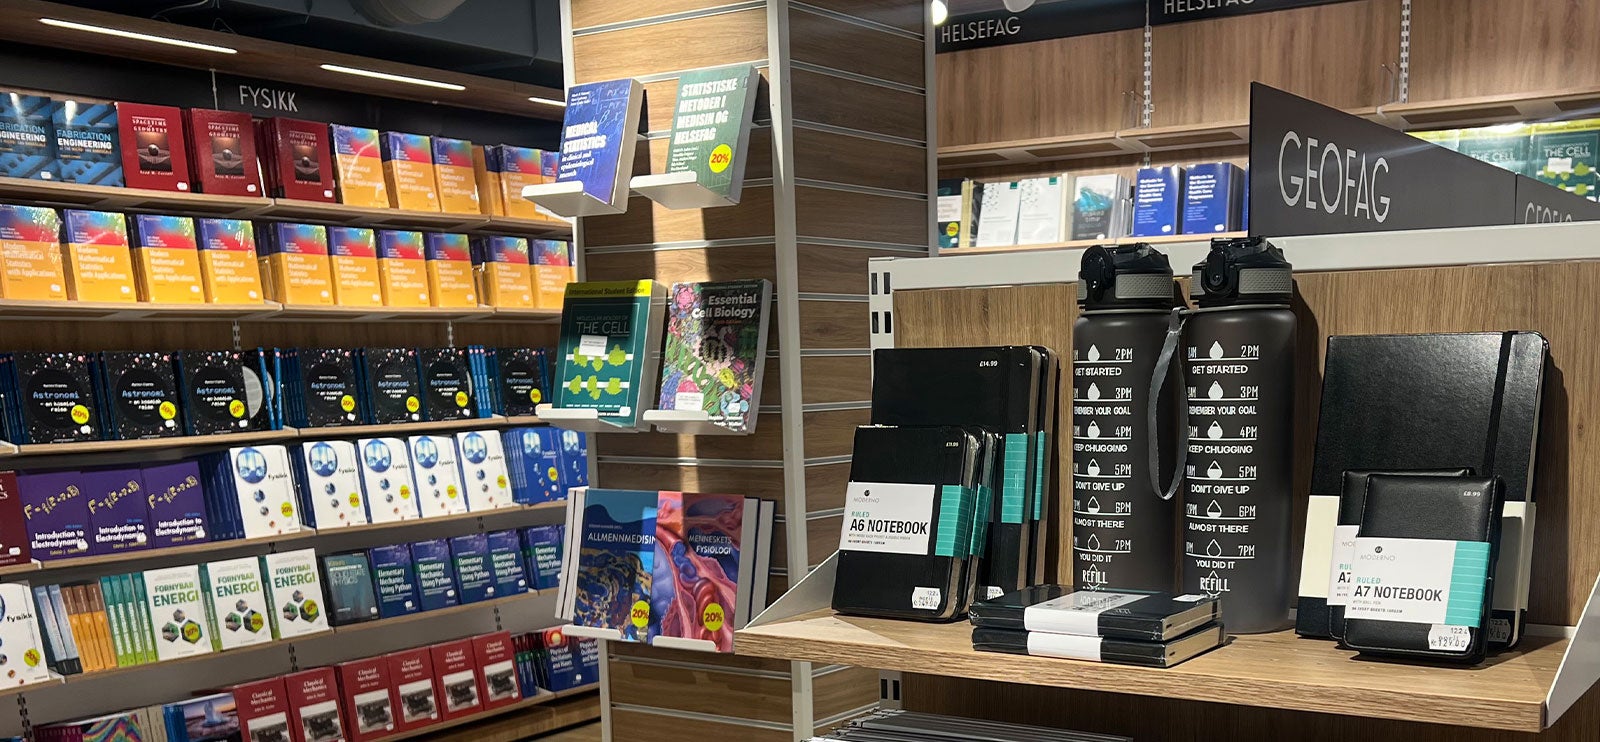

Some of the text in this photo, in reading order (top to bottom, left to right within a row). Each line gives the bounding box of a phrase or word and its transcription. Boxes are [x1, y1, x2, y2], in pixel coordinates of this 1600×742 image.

[941, 16, 1021, 43] HELSEFAG
[680, 78, 738, 97] STATISTISKE
[239, 85, 298, 112] FYSIKK
[678, 96, 721, 113] METODER
[676, 110, 729, 129] MEDISIN OG
[0, 122, 45, 134] BRICATION
[565, 120, 598, 139] MEDICAL
[0, 131, 46, 142] GINEERING
[56, 129, 111, 141] FABRICATION
[673, 127, 717, 145] HELSEFAG
[57, 138, 112, 149] ENGINEERING
[563, 134, 607, 154] STATISTICS
[1544, 145, 1591, 157] THE CELL
[711, 153, 729, 164] 20%
[1278, 130, 1390, 223] GEOFAG
[708, 293, 757, 306] Essential
[691, 307, 756, 319] Cell Biology
[576, 321, 631, 334] THE CELL
[1115, 348, 1133, 361] 2PM
[1241, 345, 1260, 358] 2PM
[1085, 367, 1122, 376] STARTED
[1192, 365, 1249, 375] GET STARTED
[33, 390, 80, 399] Astronomi
[122, 389, 165, 398] Astronomi
[196, 386, 236, 395] Astronomi
[1115, 387, 1132, 400] 3PM
[1240, 385, 1259, 399] 3PM
[1094, 406, 1111, 415] YOUR
[1114, 406, 1131, 415] GOAL
[1217, 406, 1236, 415] YOUR
[1238, 406, 1257, 415] GOAL
[1115, 425, 1132, 438] 4PM
[1240, 425, 1258, 438] 4PM
[1084, 444, 1128, 453] CHUGGING
[1204, 445, 1253, 454] CHUGGING
[1114, 463, 1132, 476] 5PM
[1239, 465, 1257, 478] 5PM
[1092, 482, 1110, 491] GIVE
[1111, 482, 1125, 491] UP
[1191, 484, 1250, 495] DON'T GIVE UP
[1115, 501, 1132, 514] 6PM
[1239, 505, 1256, 517] 6PM
[158, 519, 194, 528] Introduction
[850, 518, 928, 535] A6 NOTEBOOK
[1074, 518, 1125, 529] ALMOST THERE
[1188, 523, 1249, 533] ALMOST THERE
[35, 529, 85, 541] Introduction to
[98, 526, 136, 535] Introduction
[587, 532, 656, 545] ALLMENNMEDISIN
[688, 534, 732, 545] MENNESKETS
[696, 545, 731, 555] FYSIOLOGI
[1115, 539, 1132, 551] 7PM
[1238, 545, 1255, 556] 7PM
[1079, 553, 1113, 563] YOU DID IT
[1195, 559, 1235, 569] YOU DID IT
[1360, 554, 1396, 562] MODERNO
[275, 562, 311, 576] FORNYBAR
[419, 562, 445, 571] Elementary
[217, 573, 255, 584] FORNYBAR
[378, 568, 405, 578] Elementary
[1082, 569, 1108, 584] REFILL
[154, 581, 194, 593] FORNYBAR
[274, 573, 316, 589] ENERGI
[1200, 577, 1230, 592] REFILL
[1356, 577, 1381, 585] RULED
[216, 581, 260, 598] ENERGI
[394, 583, 412, 593] Python
[1354, 585, 1442, 602] A7 NOTEBOOK
[153, 590, 200, 607] ENERGI
[6, 612, 33, 623] fysikk
[633, 608, 650, 620] 20%
[704, 612, 723, 623] 20%
